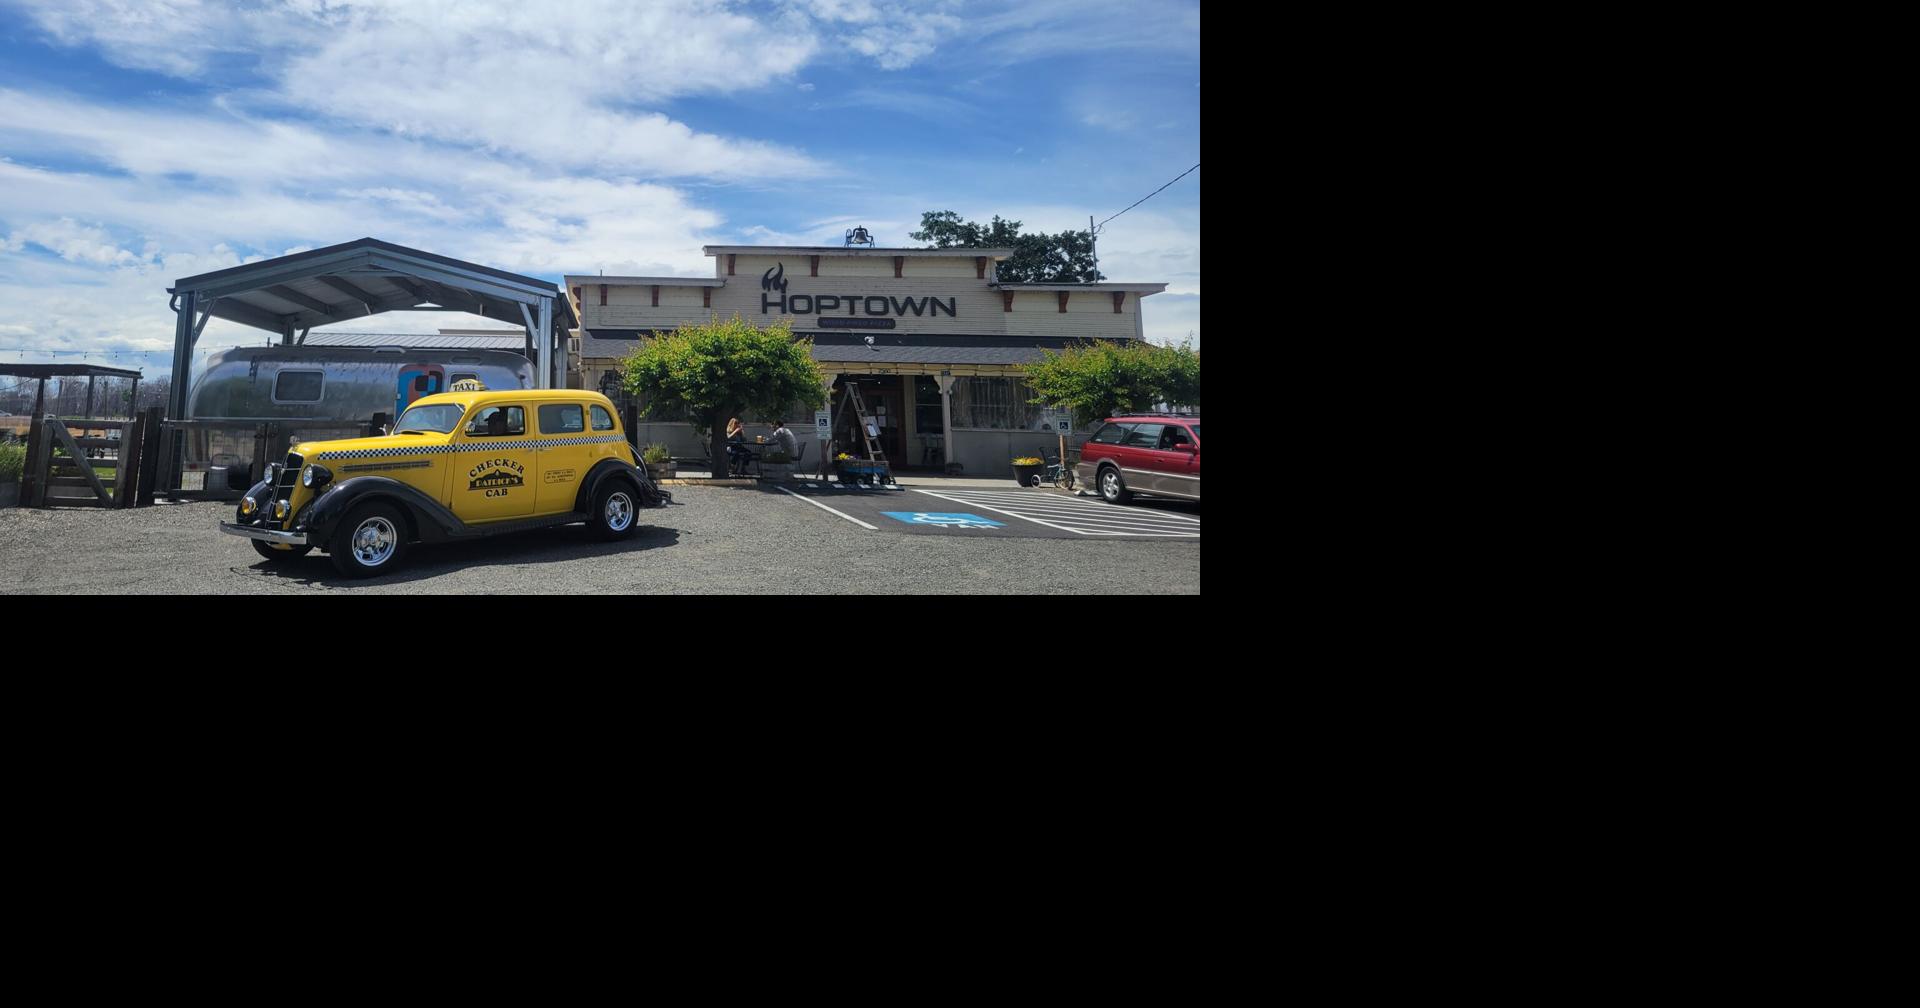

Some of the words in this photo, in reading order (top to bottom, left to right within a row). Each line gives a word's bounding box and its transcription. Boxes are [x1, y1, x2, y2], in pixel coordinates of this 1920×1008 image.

[761, 292, 957, 318] HOPTOWN
[452, 382, 476, 392] TAXI
[469, 458, 525, 478] CHECKER
[485, 488, 508, 498] CAB
